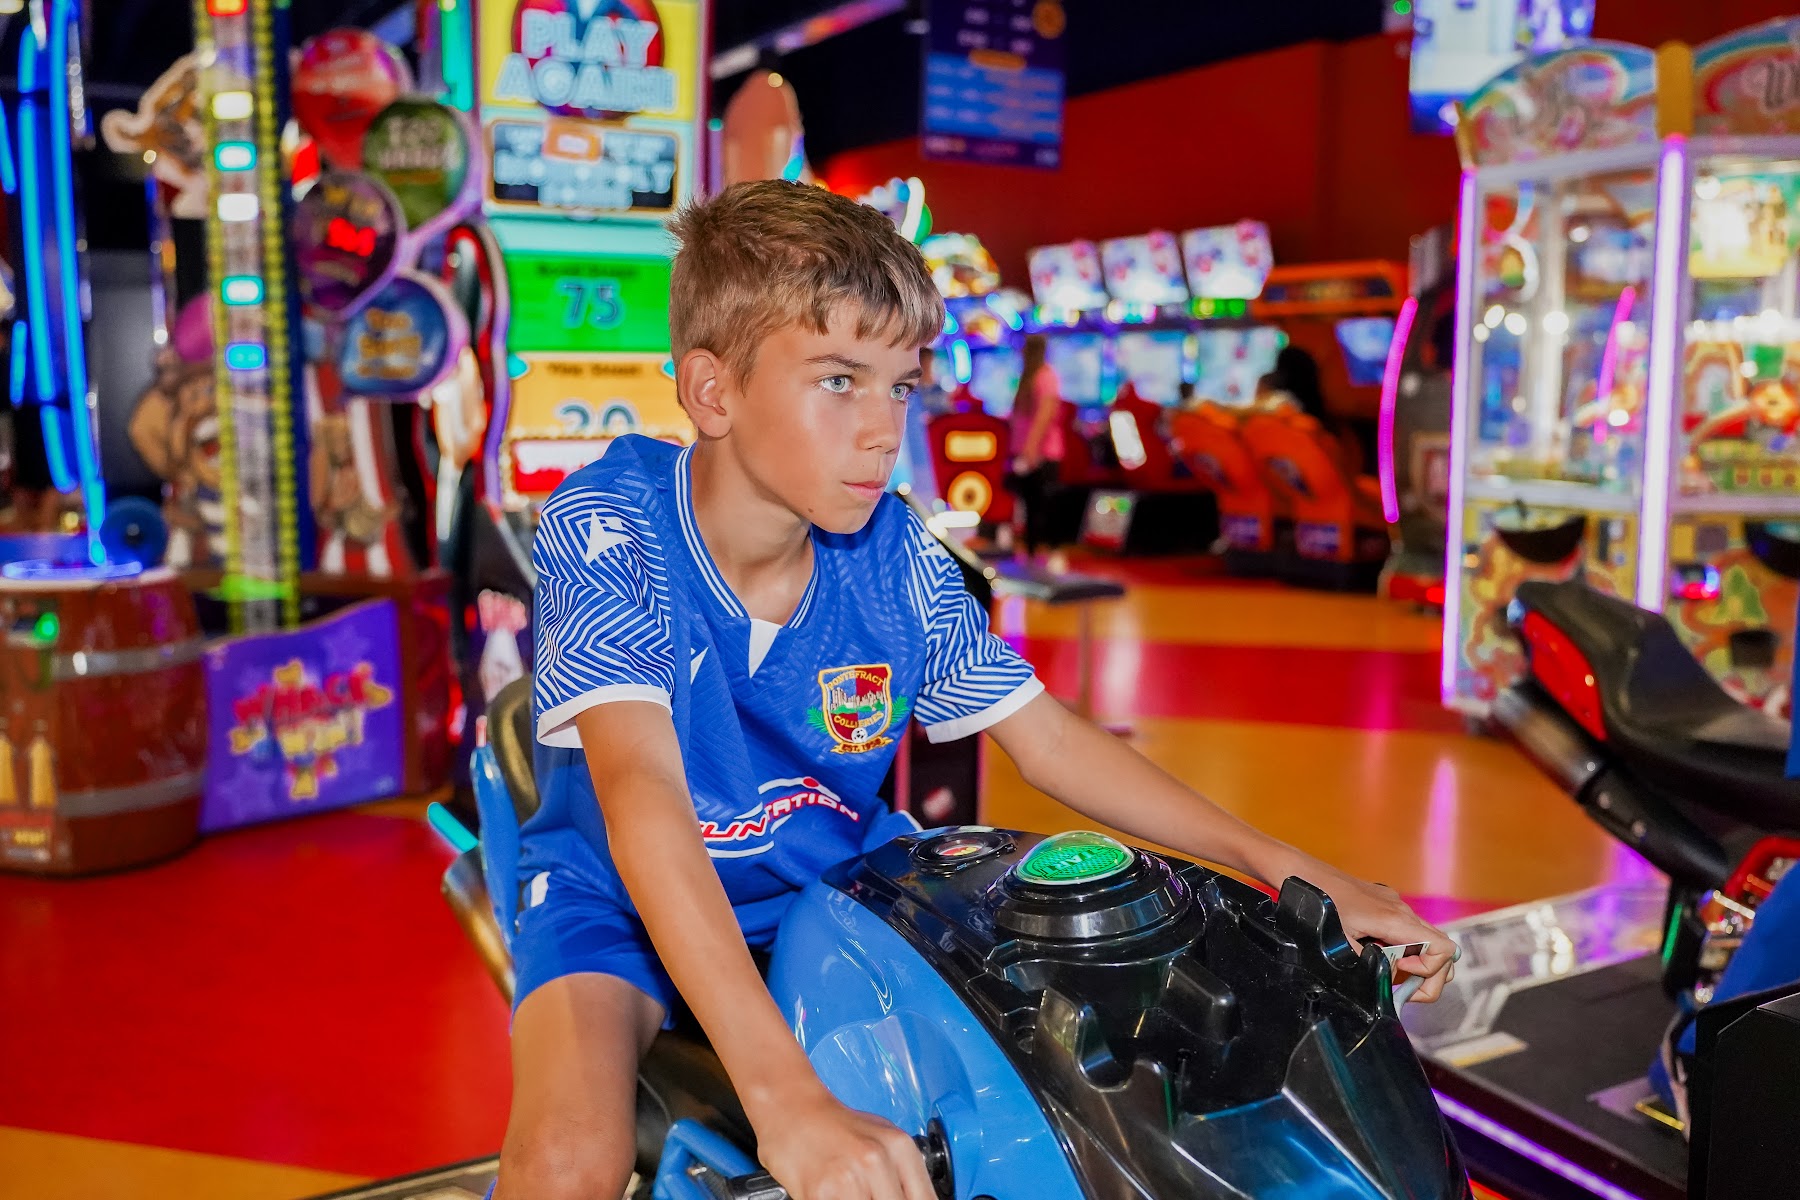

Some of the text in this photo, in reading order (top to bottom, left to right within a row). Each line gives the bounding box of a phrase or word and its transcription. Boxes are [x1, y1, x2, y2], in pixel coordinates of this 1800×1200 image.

[521, 8, 659, 68] PLAY
[558, 279, 622, 327] 75
[827, 670, 884, 690] PONTEFRACT
[833, 711, 885, 729] COLLIERIES
[699, 792, 861, 841] UN TATION
